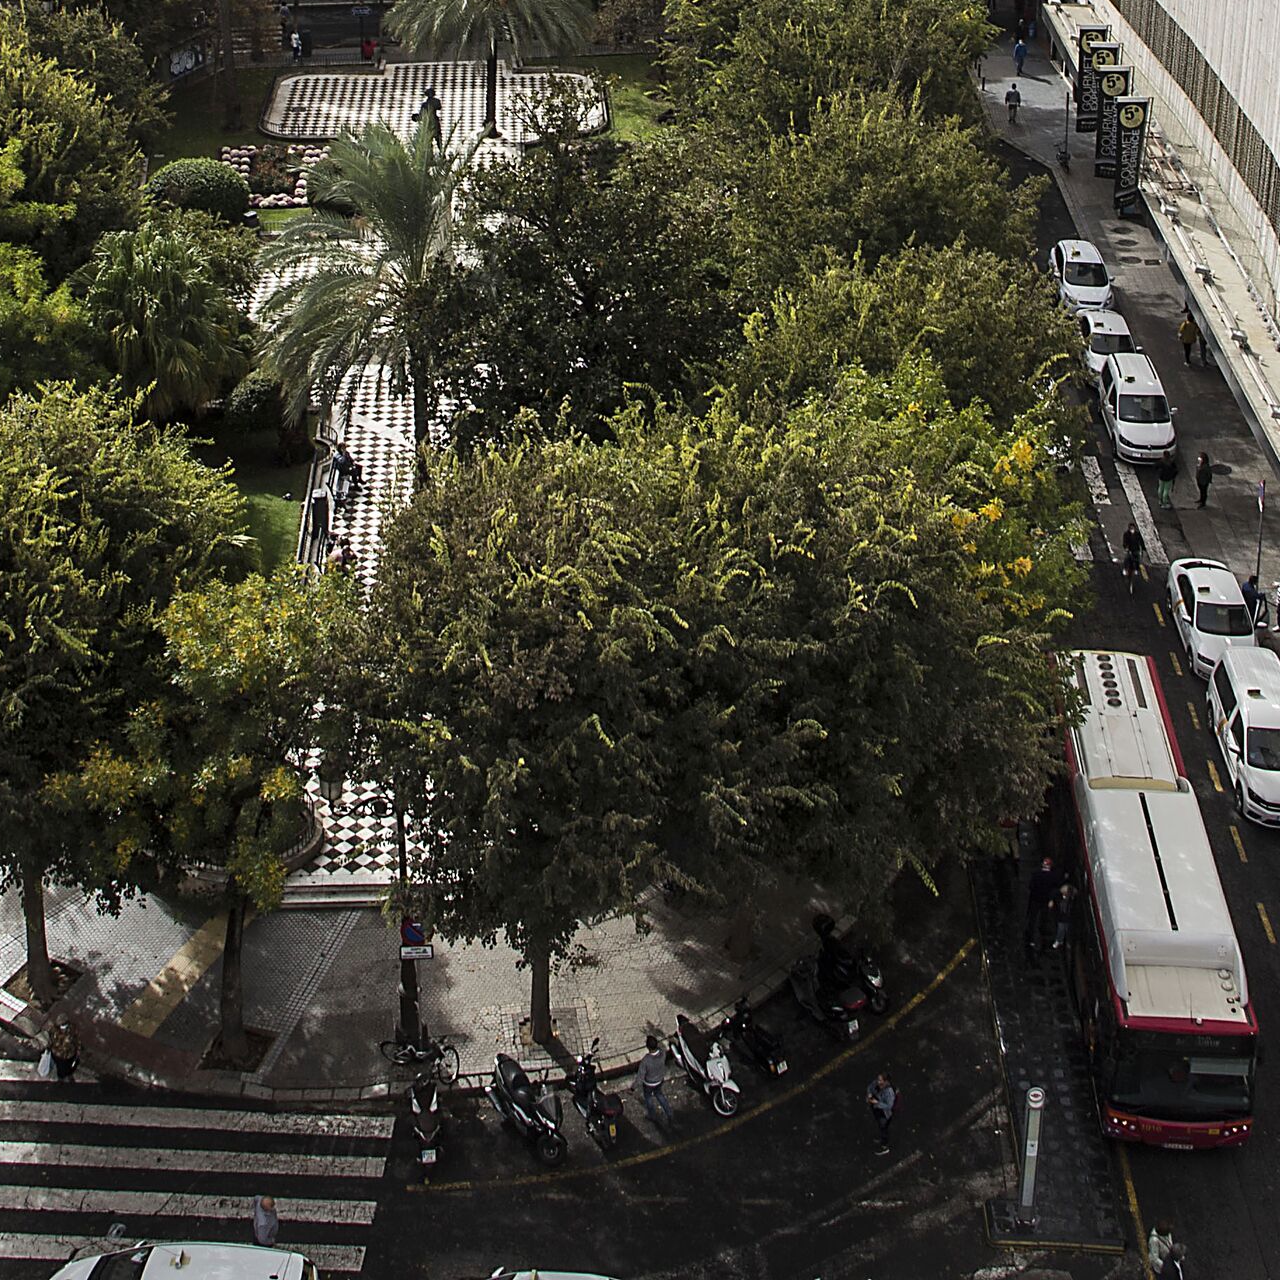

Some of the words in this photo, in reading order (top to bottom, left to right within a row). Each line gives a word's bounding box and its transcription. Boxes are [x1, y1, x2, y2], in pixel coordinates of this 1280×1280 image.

[1082, 56, 1093, 111] GOURMET
[1100, 98, 1113, 156] GOURMET
[1121, 129, 1132, 188] GOURMET
[1128, 129, 1140, 186] EXPERIENCE
